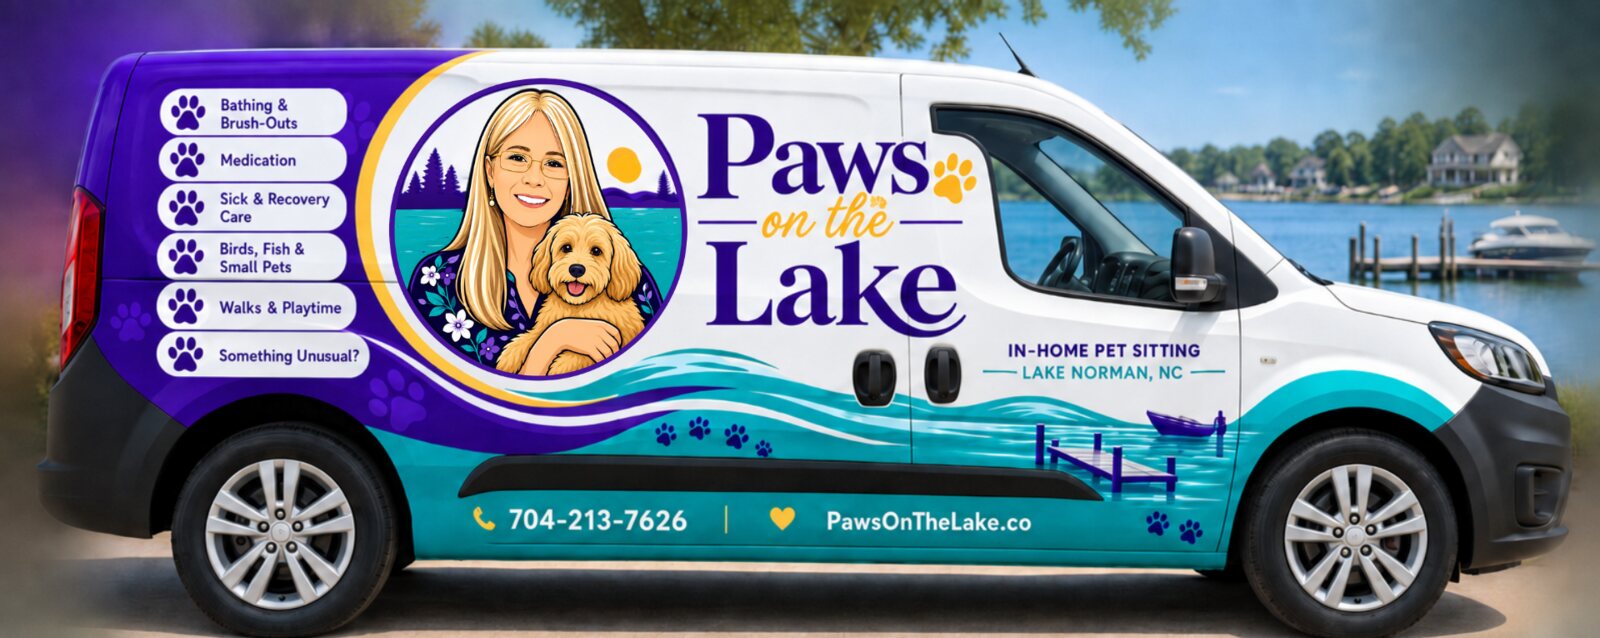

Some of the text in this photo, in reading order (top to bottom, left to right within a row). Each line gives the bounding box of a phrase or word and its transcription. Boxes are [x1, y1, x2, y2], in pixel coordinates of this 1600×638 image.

[220, 98, 288, 114] Bathing &
[220, 116, 298, 130] Brush-Outs
[220, 153, 297, 167] Medication
[697, 113, 930, 199] Paws
[220, 192, 330, 209] Sick & Recovery
[220, 210, 252, 223] Care
[761, 191, 895, 238] on the
[219, 242, 305, 258] Birds, Fish &
[219, 260, 292, 273] Small Pets
[706, 240, 967, 338] Lake
[219, 301, 342, 317] Walks & Playtime
[219, 349, 360, 365] Something Unusual?
[1008, 343, 1201, 358] IN-HOME PET SITTING
[1022, 365, 1183, 382] LAKE NORMAN, NC
[508, 508, 688, 532] 704-213-7626
[826, 511, 1032, 533] PawsOnTheLake.co
